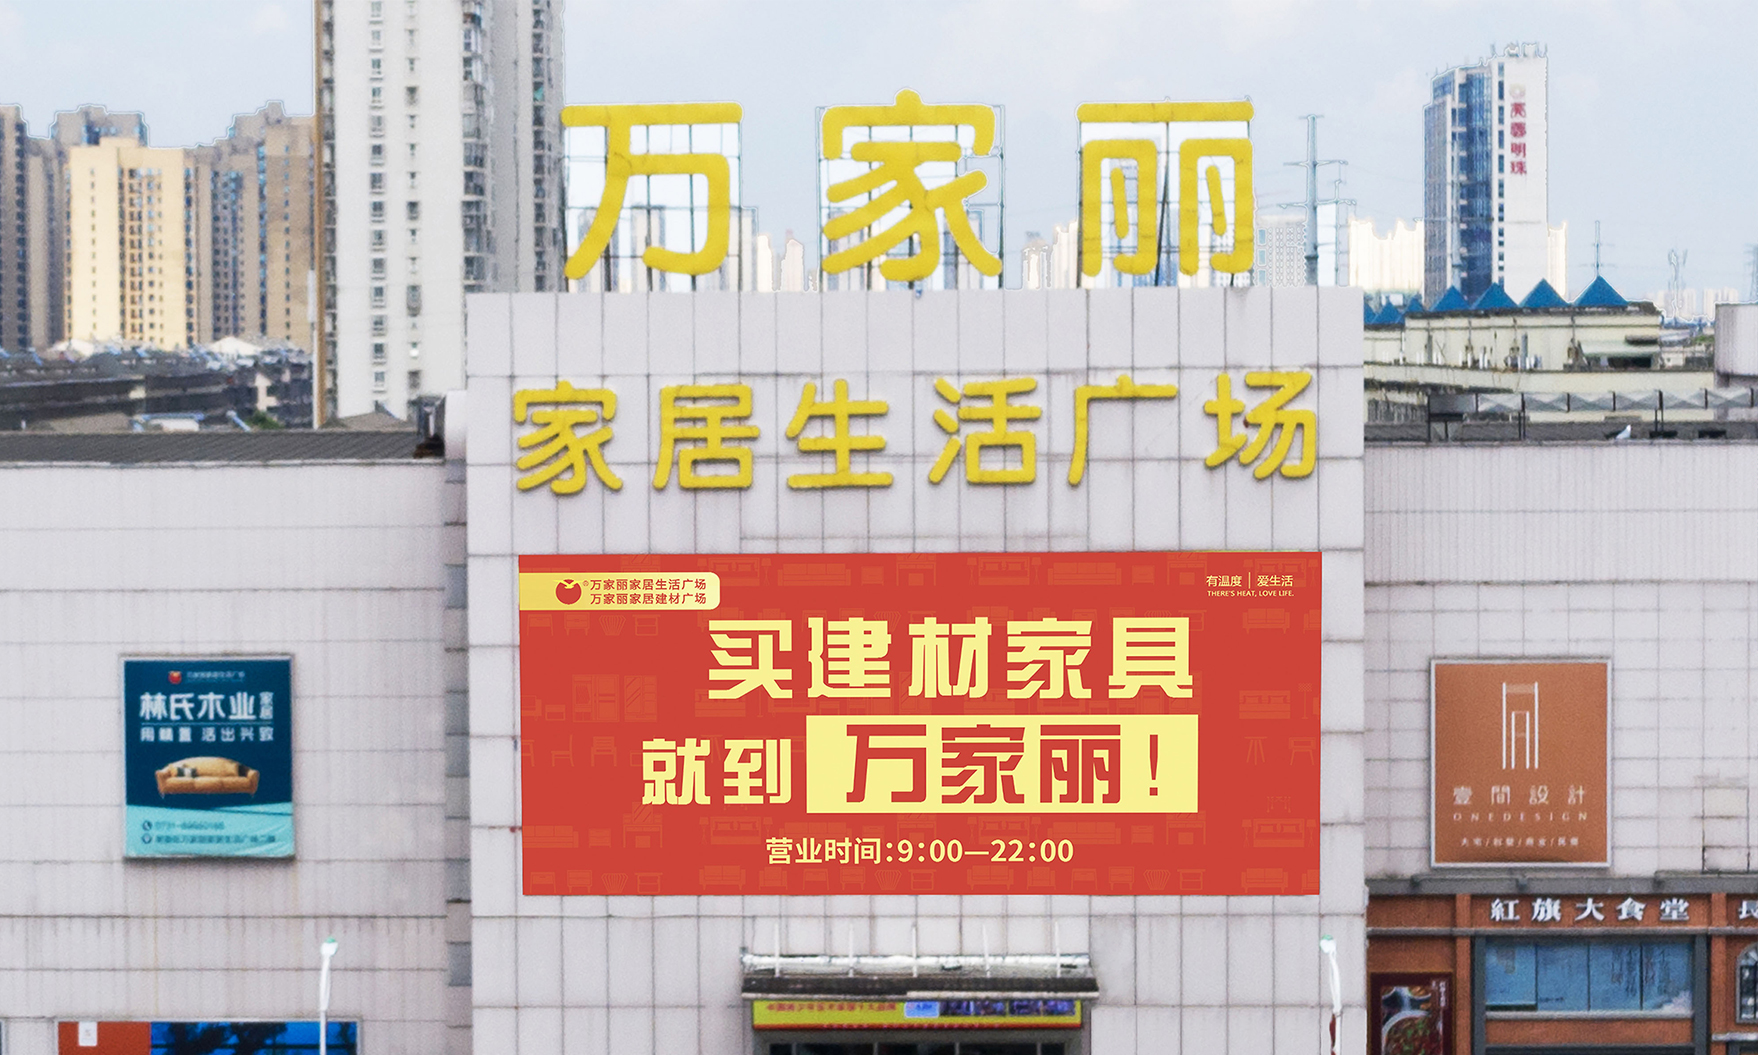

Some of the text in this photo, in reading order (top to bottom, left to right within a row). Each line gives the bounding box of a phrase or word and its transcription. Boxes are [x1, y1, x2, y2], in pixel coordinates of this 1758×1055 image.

[562, 89, 1254, 282] 万家丽
[513, 371, 1317, 495] 家居生活广场
[590, 579, 707, 591] 万家丽家居生活广场
[1206, 575, 1294, 587] 有温度 爱生活
[590, 593, 707, 604] 万家丽家居建材广场
[707, 617, 1193, 699] 买建材家具
[139, 692, 256, 720] 林氏木业
[642, 739, 791, 805] 就到
[1490, 898, 1690, 922] 紅旗大食堂
